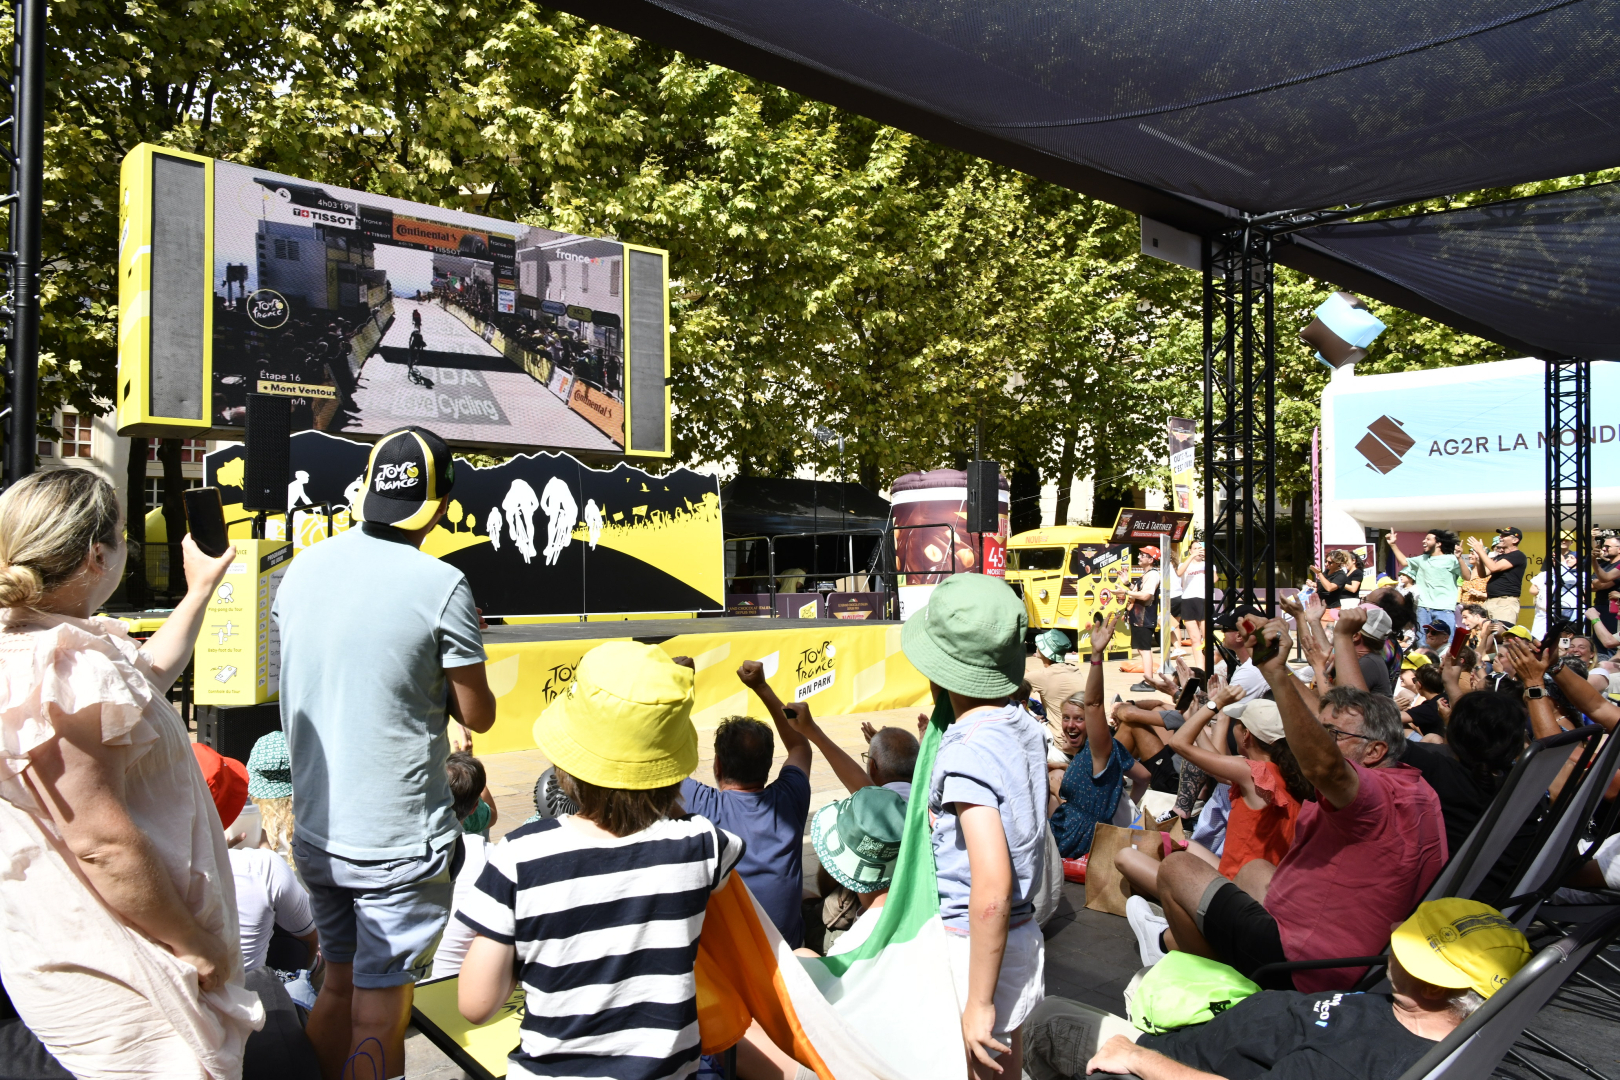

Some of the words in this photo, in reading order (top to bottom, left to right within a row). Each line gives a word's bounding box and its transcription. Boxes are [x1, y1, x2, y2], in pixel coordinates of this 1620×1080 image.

[310, 211, 354, 226] TISSOT
[396, 224, 450, 242] Continental
[435, 246, 461, 256] TISSOT
[555, 248, 590, 264] france
[260, 370, 287, 381] Étape
[290, 373, 301, 382] 16
[270, 383, 296, 393] Mont
[299, 385, 337, 397] Ventoux
[439, 393, 499, 420] Cycling
[574, 389, 608, 416] Continental
[1428, 436, 1489, 457] AG2R
[1498, 433, 1529, 452] LA
[1537, 424, 1620, 449] MOND
[1151, 521, 1173, 531] TARTINER
[798, 684, 812, 698] FAN
[813, 674, 832, 691] PARK
[1493, 973, 1509, 986] LC
